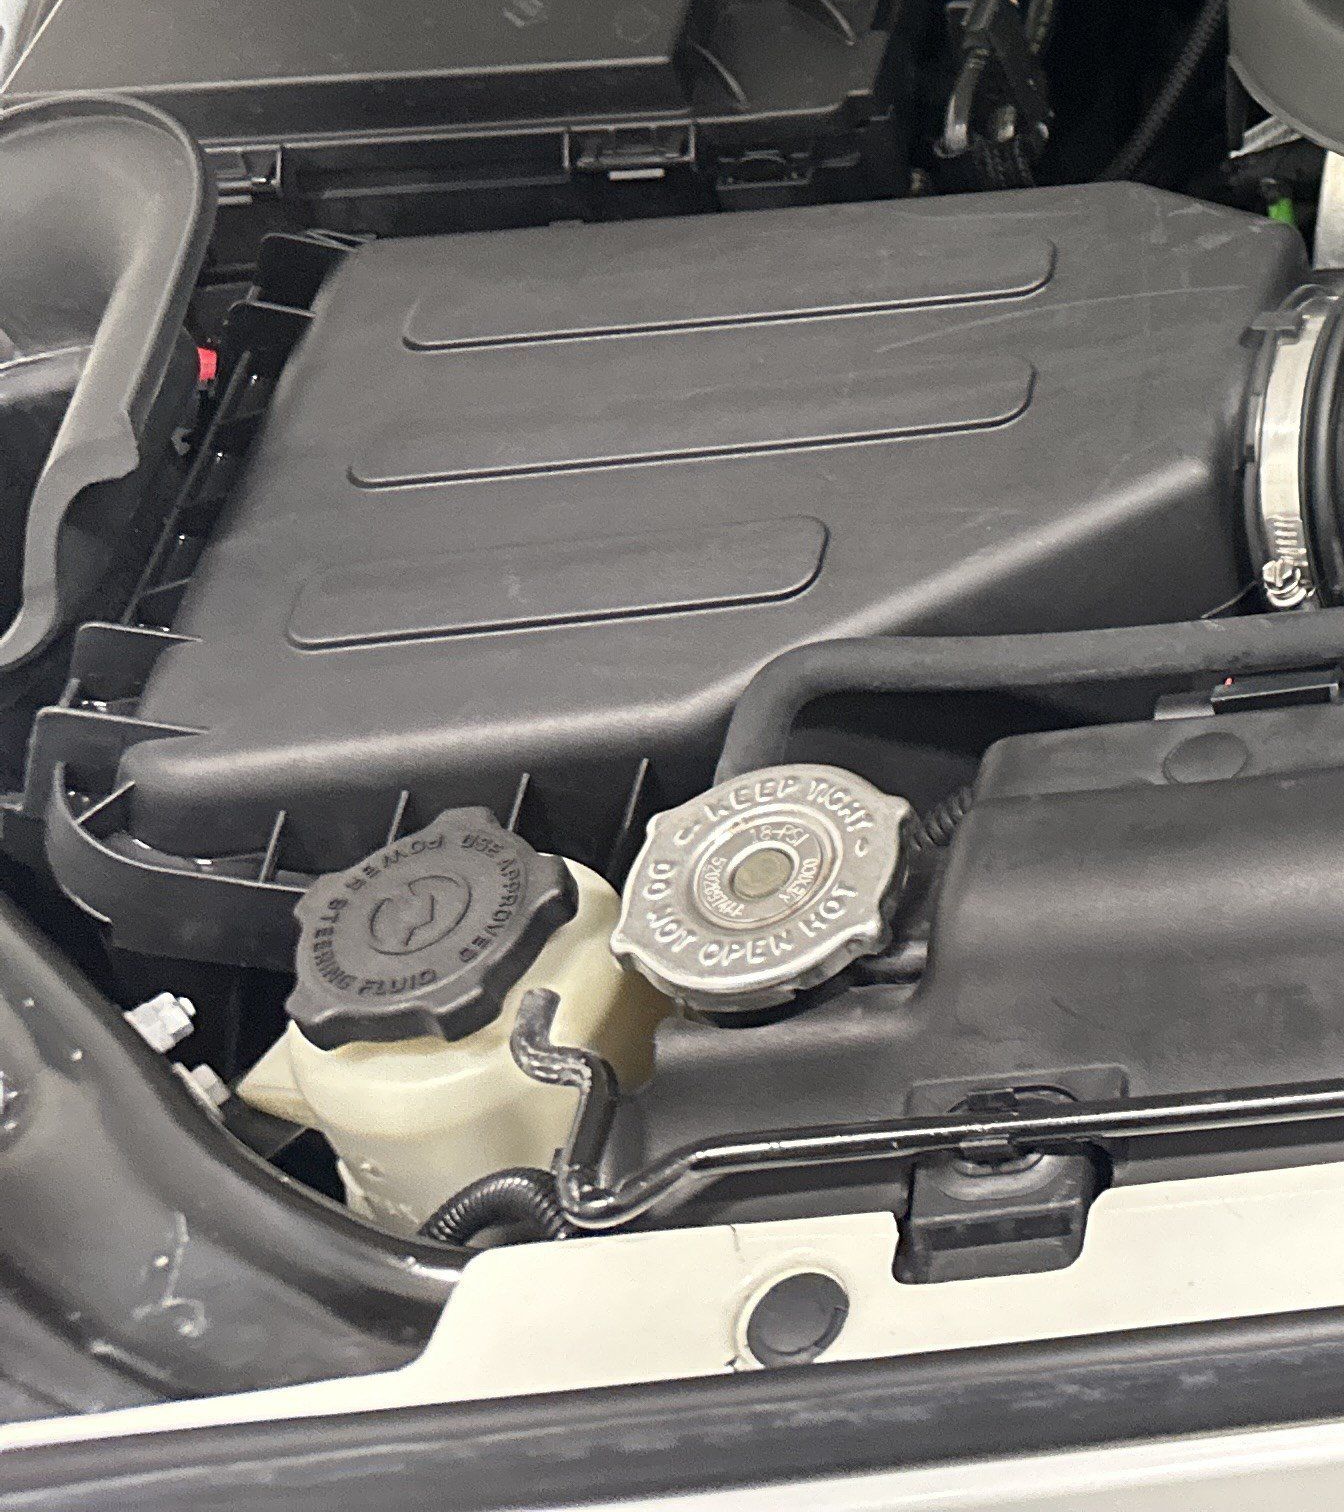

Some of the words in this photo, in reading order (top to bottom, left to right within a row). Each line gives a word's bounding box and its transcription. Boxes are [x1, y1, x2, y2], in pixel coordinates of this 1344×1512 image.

[703, 778, 799, 822] KEEP
[345, 834, 444, 892] POWER
[460, 834, 502, 857] USE
[641, 863, 677, 901] DO
[459, 858, 521, 964] APPROVED
[646, 906, 697, 954] NOT
[799, 883, 858, 938] HOT
[314, 897, 358, 991] STEERING
[698, 930, 795, 967] OPEN
[358, 968, 437, 996] FLUID
